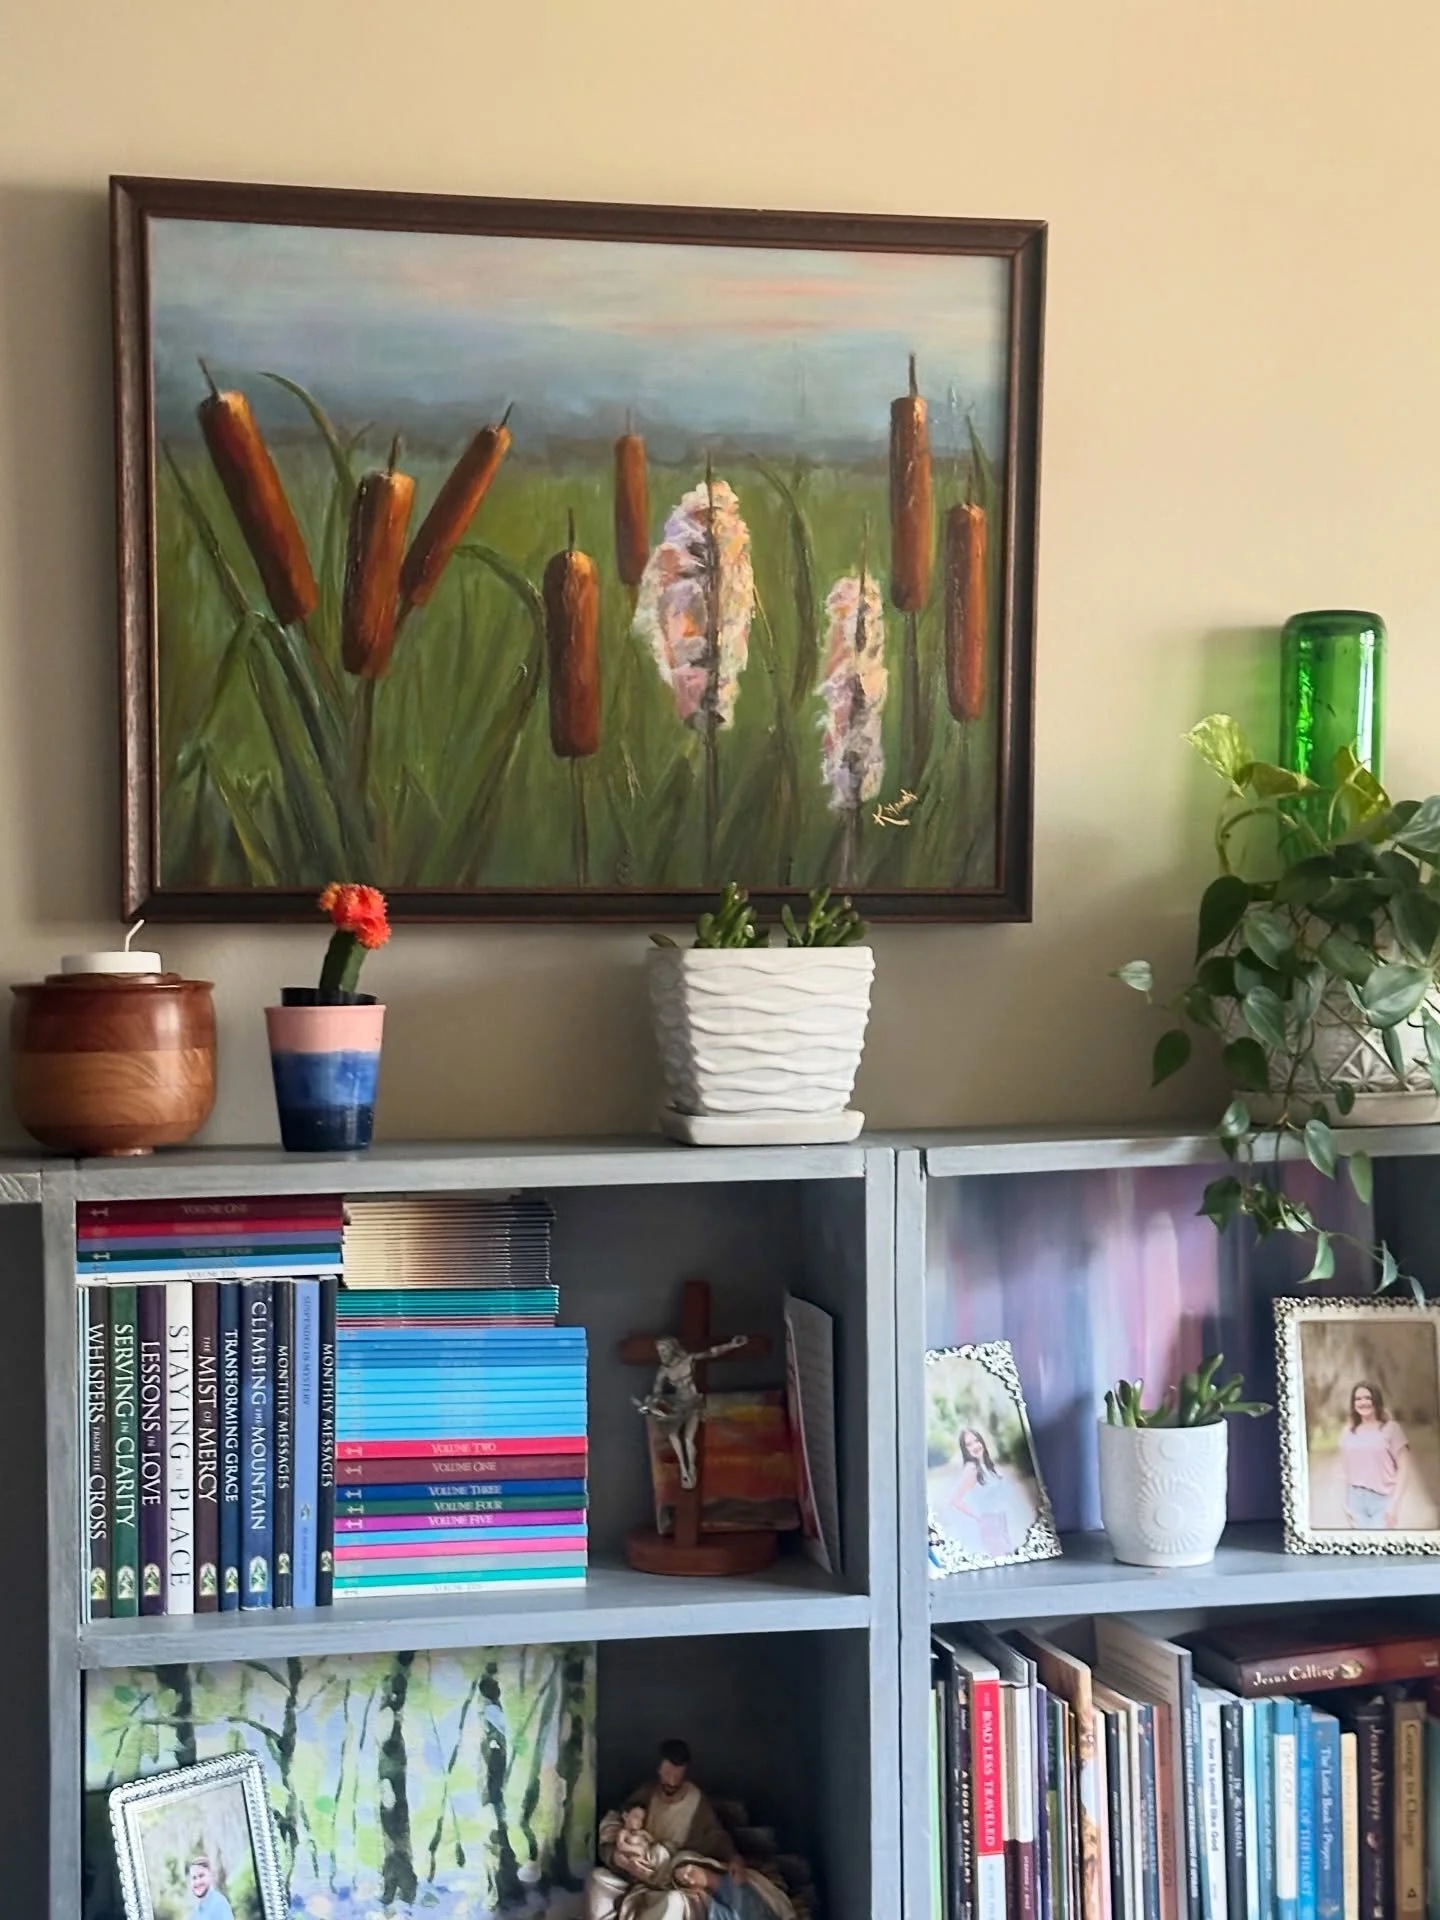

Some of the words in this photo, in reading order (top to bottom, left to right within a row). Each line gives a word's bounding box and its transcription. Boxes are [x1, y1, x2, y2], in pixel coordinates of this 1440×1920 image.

[203, 1337, 211, 1351] THE
[252, 1302, 266, 1405] CLIMBING
[89, 1324, 106, 1423] WHISPERS
[114, 1324, 134, 1417] SERVING
[142, 1341, 160, 1432] LESSONS
[198, 1355, 217, 1408] MIST
[225, 1329, 238, 1449] TRANSFORMING
[278, 1345, 288, 1415] MONTHLY
[303, 1363, 311, 1405] MYSTERY
[321, 1344, 333, 1415] MONTHLY
[169, 1325, 190, 1459] STAYING
[120, 1422, 129, 1432] IN
[203, 1411, 212, 1423] OF
[93, 1426, 101, 1452] FROM
[147, 1436, 155, 1446] IN
[278, 1421, 289, 1489] MESSAGES
[321, 1419, 333, 1487] MESSAGES
[432, 1444, 470, 1453] VOLUME
[473, 1443, 497, 1452] TWO
[93, 1455, 102, 1471] THE
[142, 1452, 161, 1505] LOVE
[175, 1468, 184, 1480] IN
[198, 1428, 217, 1503] MERCY
[225, 1453, 238, 1502] GRACE
[252, 1426, 266, 1529] MOUNTAIN
[432, 1463, 471, 1472] VOLUME
[473, 1462, 496, 1471] ONE
[116, 1437, 135, 1528] CLARITY
[429, 1486, 469, 1496] VOLUME
[472, 1485, 502, 1495] THREE
[90, 1474, 106, 1539] CROSS
[428, 1516, 467, 1525] VOLUME
[470, 1515, 494, 1524] FIVE
[434, 1502, 473, 1511] VOLUME
[475, 1501, 503, 1510] FOUR
[170, 1488, 191, 1587] PLACE
[1253, 1672, 1287, 1686] Jesus
[1289, 1663, 1337, 1680] Calling
[982, 1711, 993, 1743] ROAD
[1370, 1725, 1384, 1763] Jesus
[983, 1746, 994, 1775] LESS
[1208, 1739, 1217, 1759] how
[1320, 1748, 1331, 1767] The
[1404, 1724, 1419, 1777] Courage
[1208, 1763, 1217, 1773] to
[1321, 1770, 1331, 1795] Little
[1209, 1778, 1218, 1805] smell
[1367, 1768, 1384, 1820] Always
[1406, 1781, 1417, 1794] to
[984, 1781, 996, 1847] TRAVELED
[1210, 1808, 1218, 1827] like
[1322, 1799, 1332, 1823] Book
[1404, 1799, 1420, 1847] Change
[1211, 1831, 1219, 1851] God
[1321, 1834, 1333, 1870] Prayers
[1301, 1857, 1312, 1896] HEART
